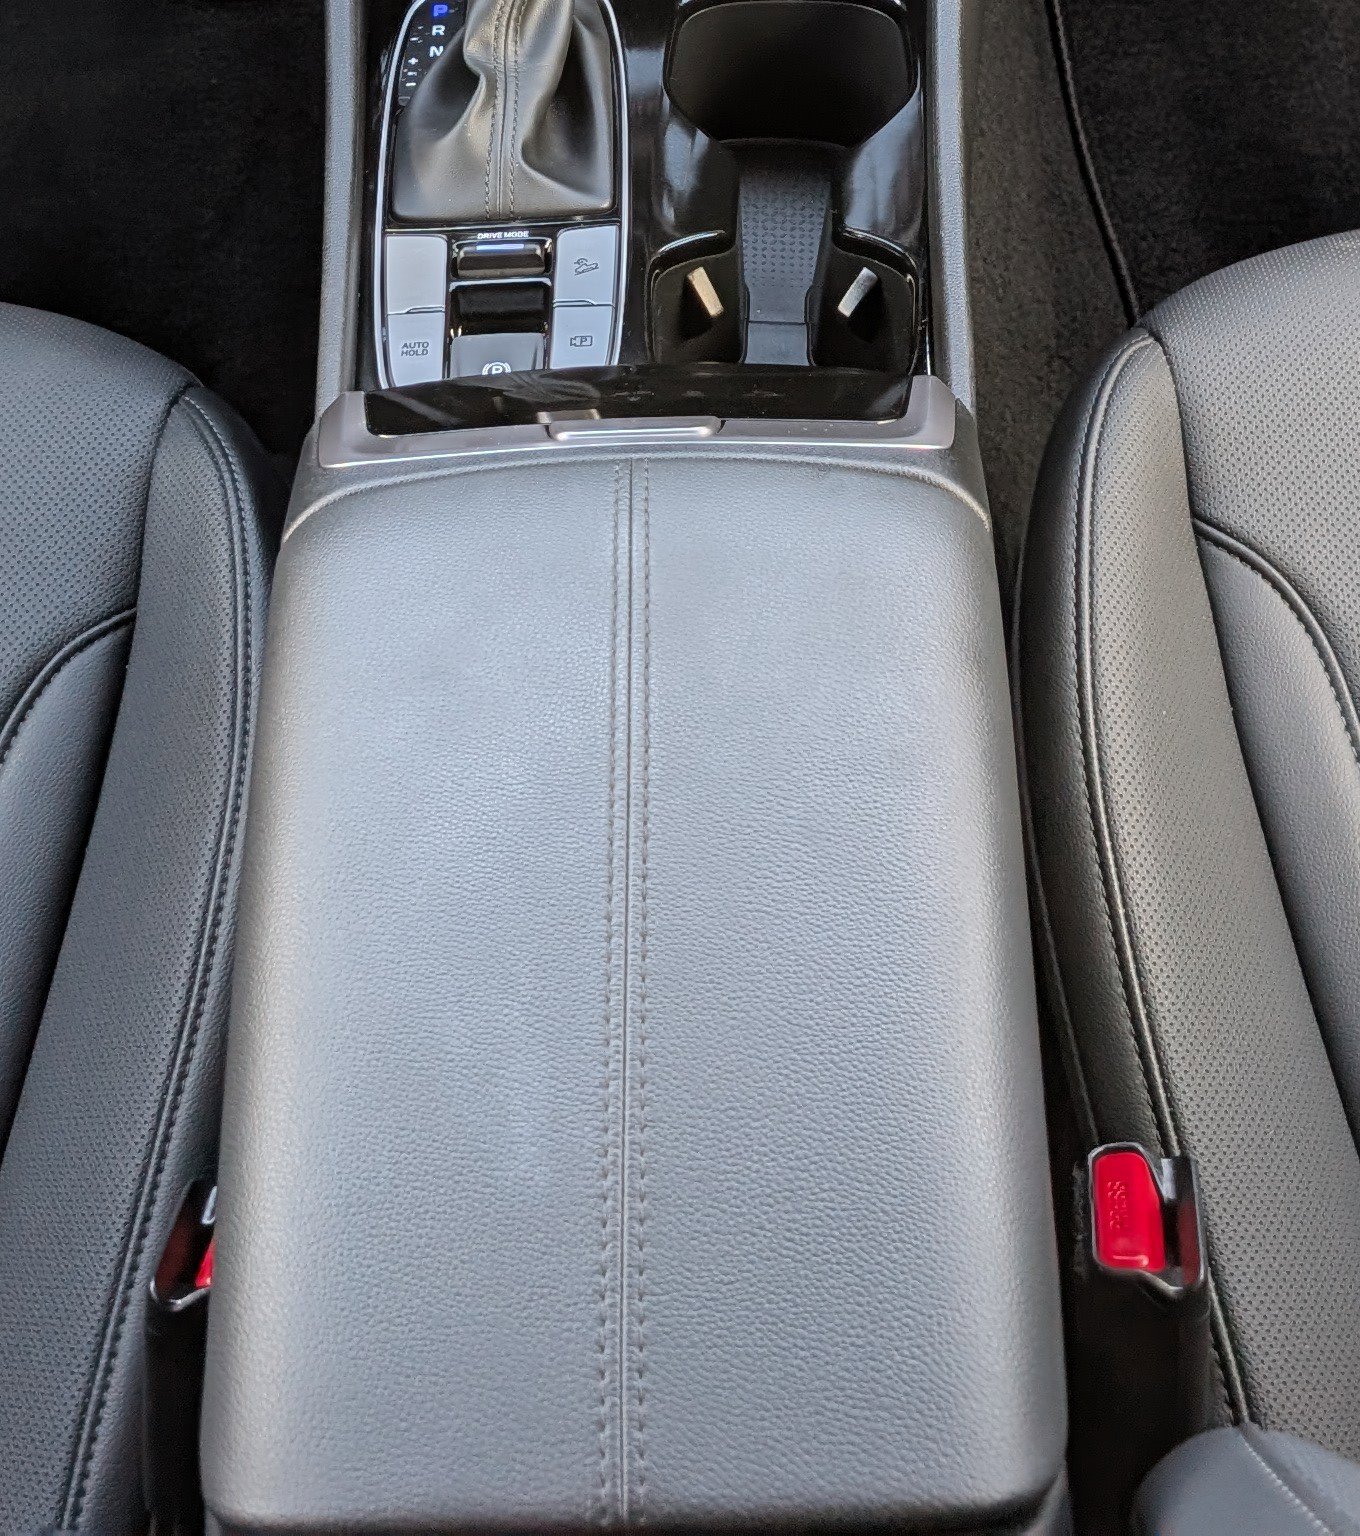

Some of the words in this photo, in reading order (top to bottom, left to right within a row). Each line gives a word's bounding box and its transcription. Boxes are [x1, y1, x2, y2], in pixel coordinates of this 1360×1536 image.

[433, 4, 448, 17] P
[431, 24, 446, 36] R
[429, 45, 444, 58] N
[477, 231, 503, 239] DRIVE
[504, 230, 529, 238] MODE
[401, 341, 430, 349] AUTO
[400, 349, 429, 357] HOLD
